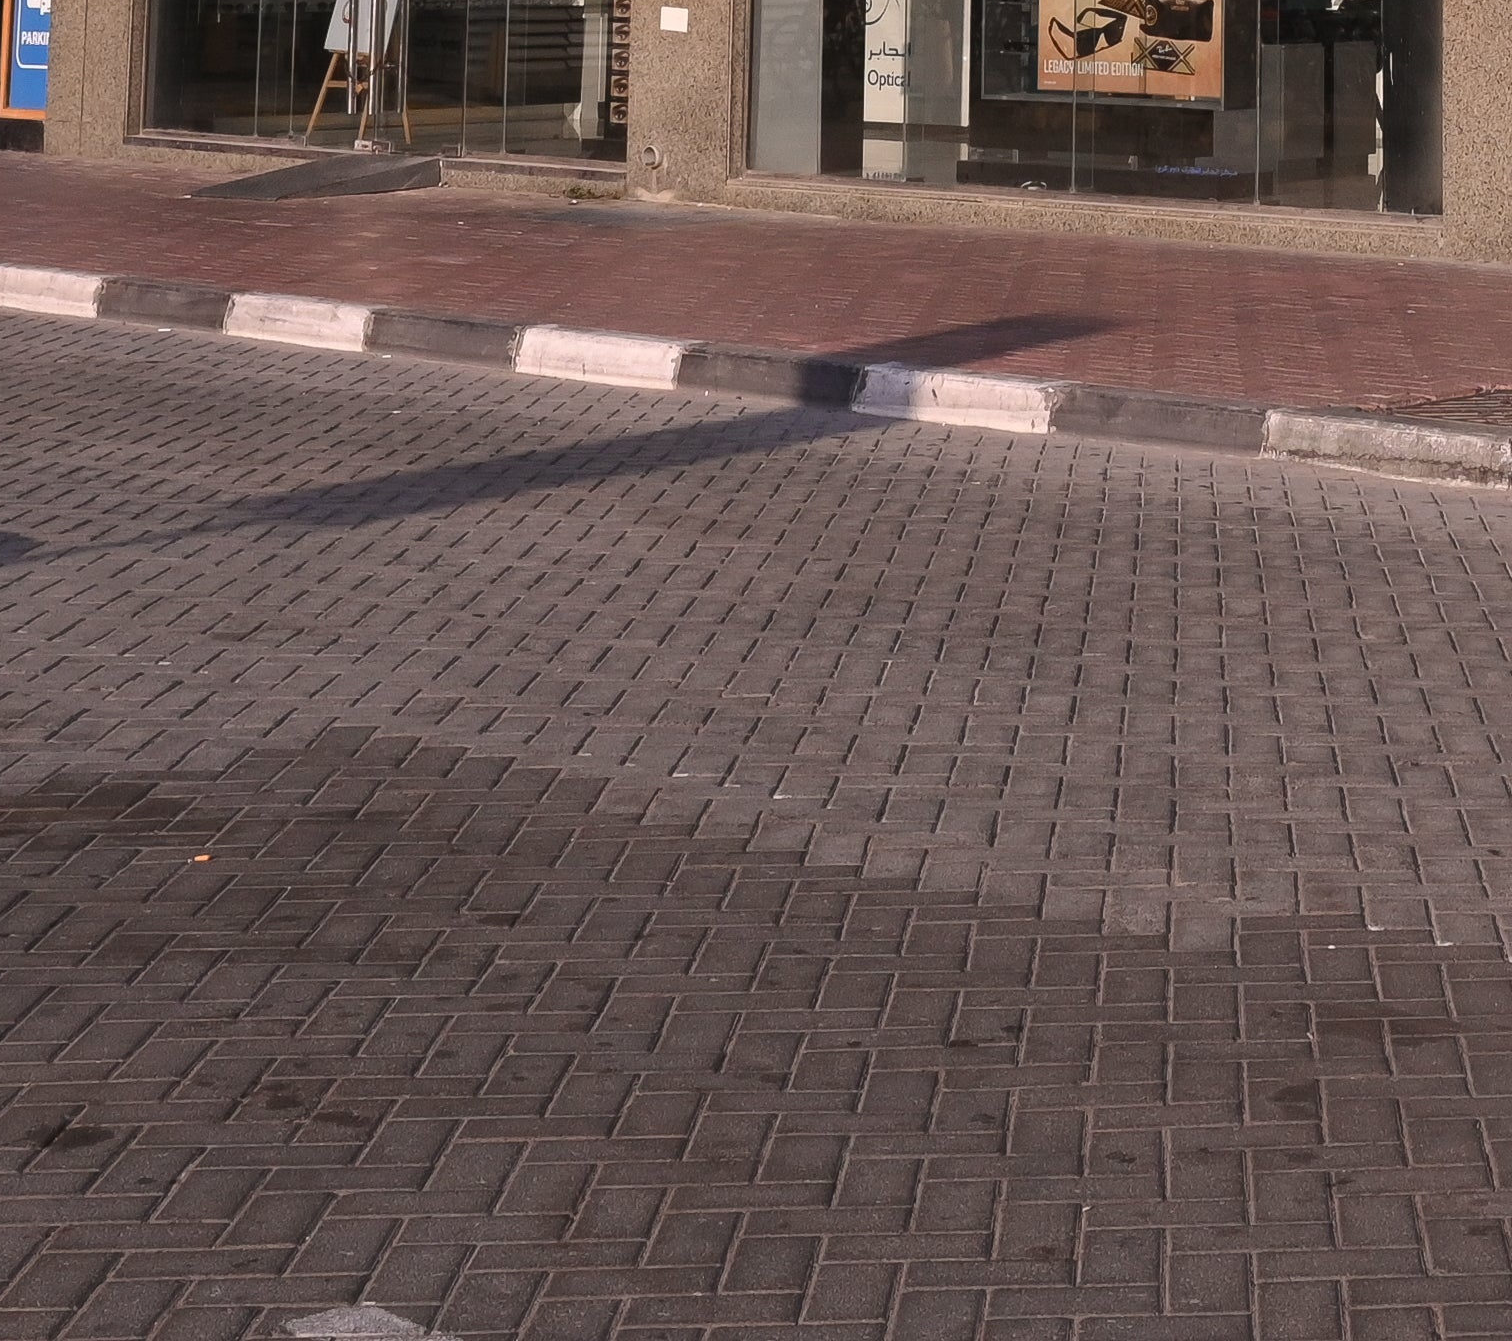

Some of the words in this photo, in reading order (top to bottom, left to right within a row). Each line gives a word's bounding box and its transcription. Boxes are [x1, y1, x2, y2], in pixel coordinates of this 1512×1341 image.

[1043, 59, 1075, 74] LEGACY
[1077, 60, 1109, 75] LIMITED
[1111, 61, 1144, 77] EDITION
